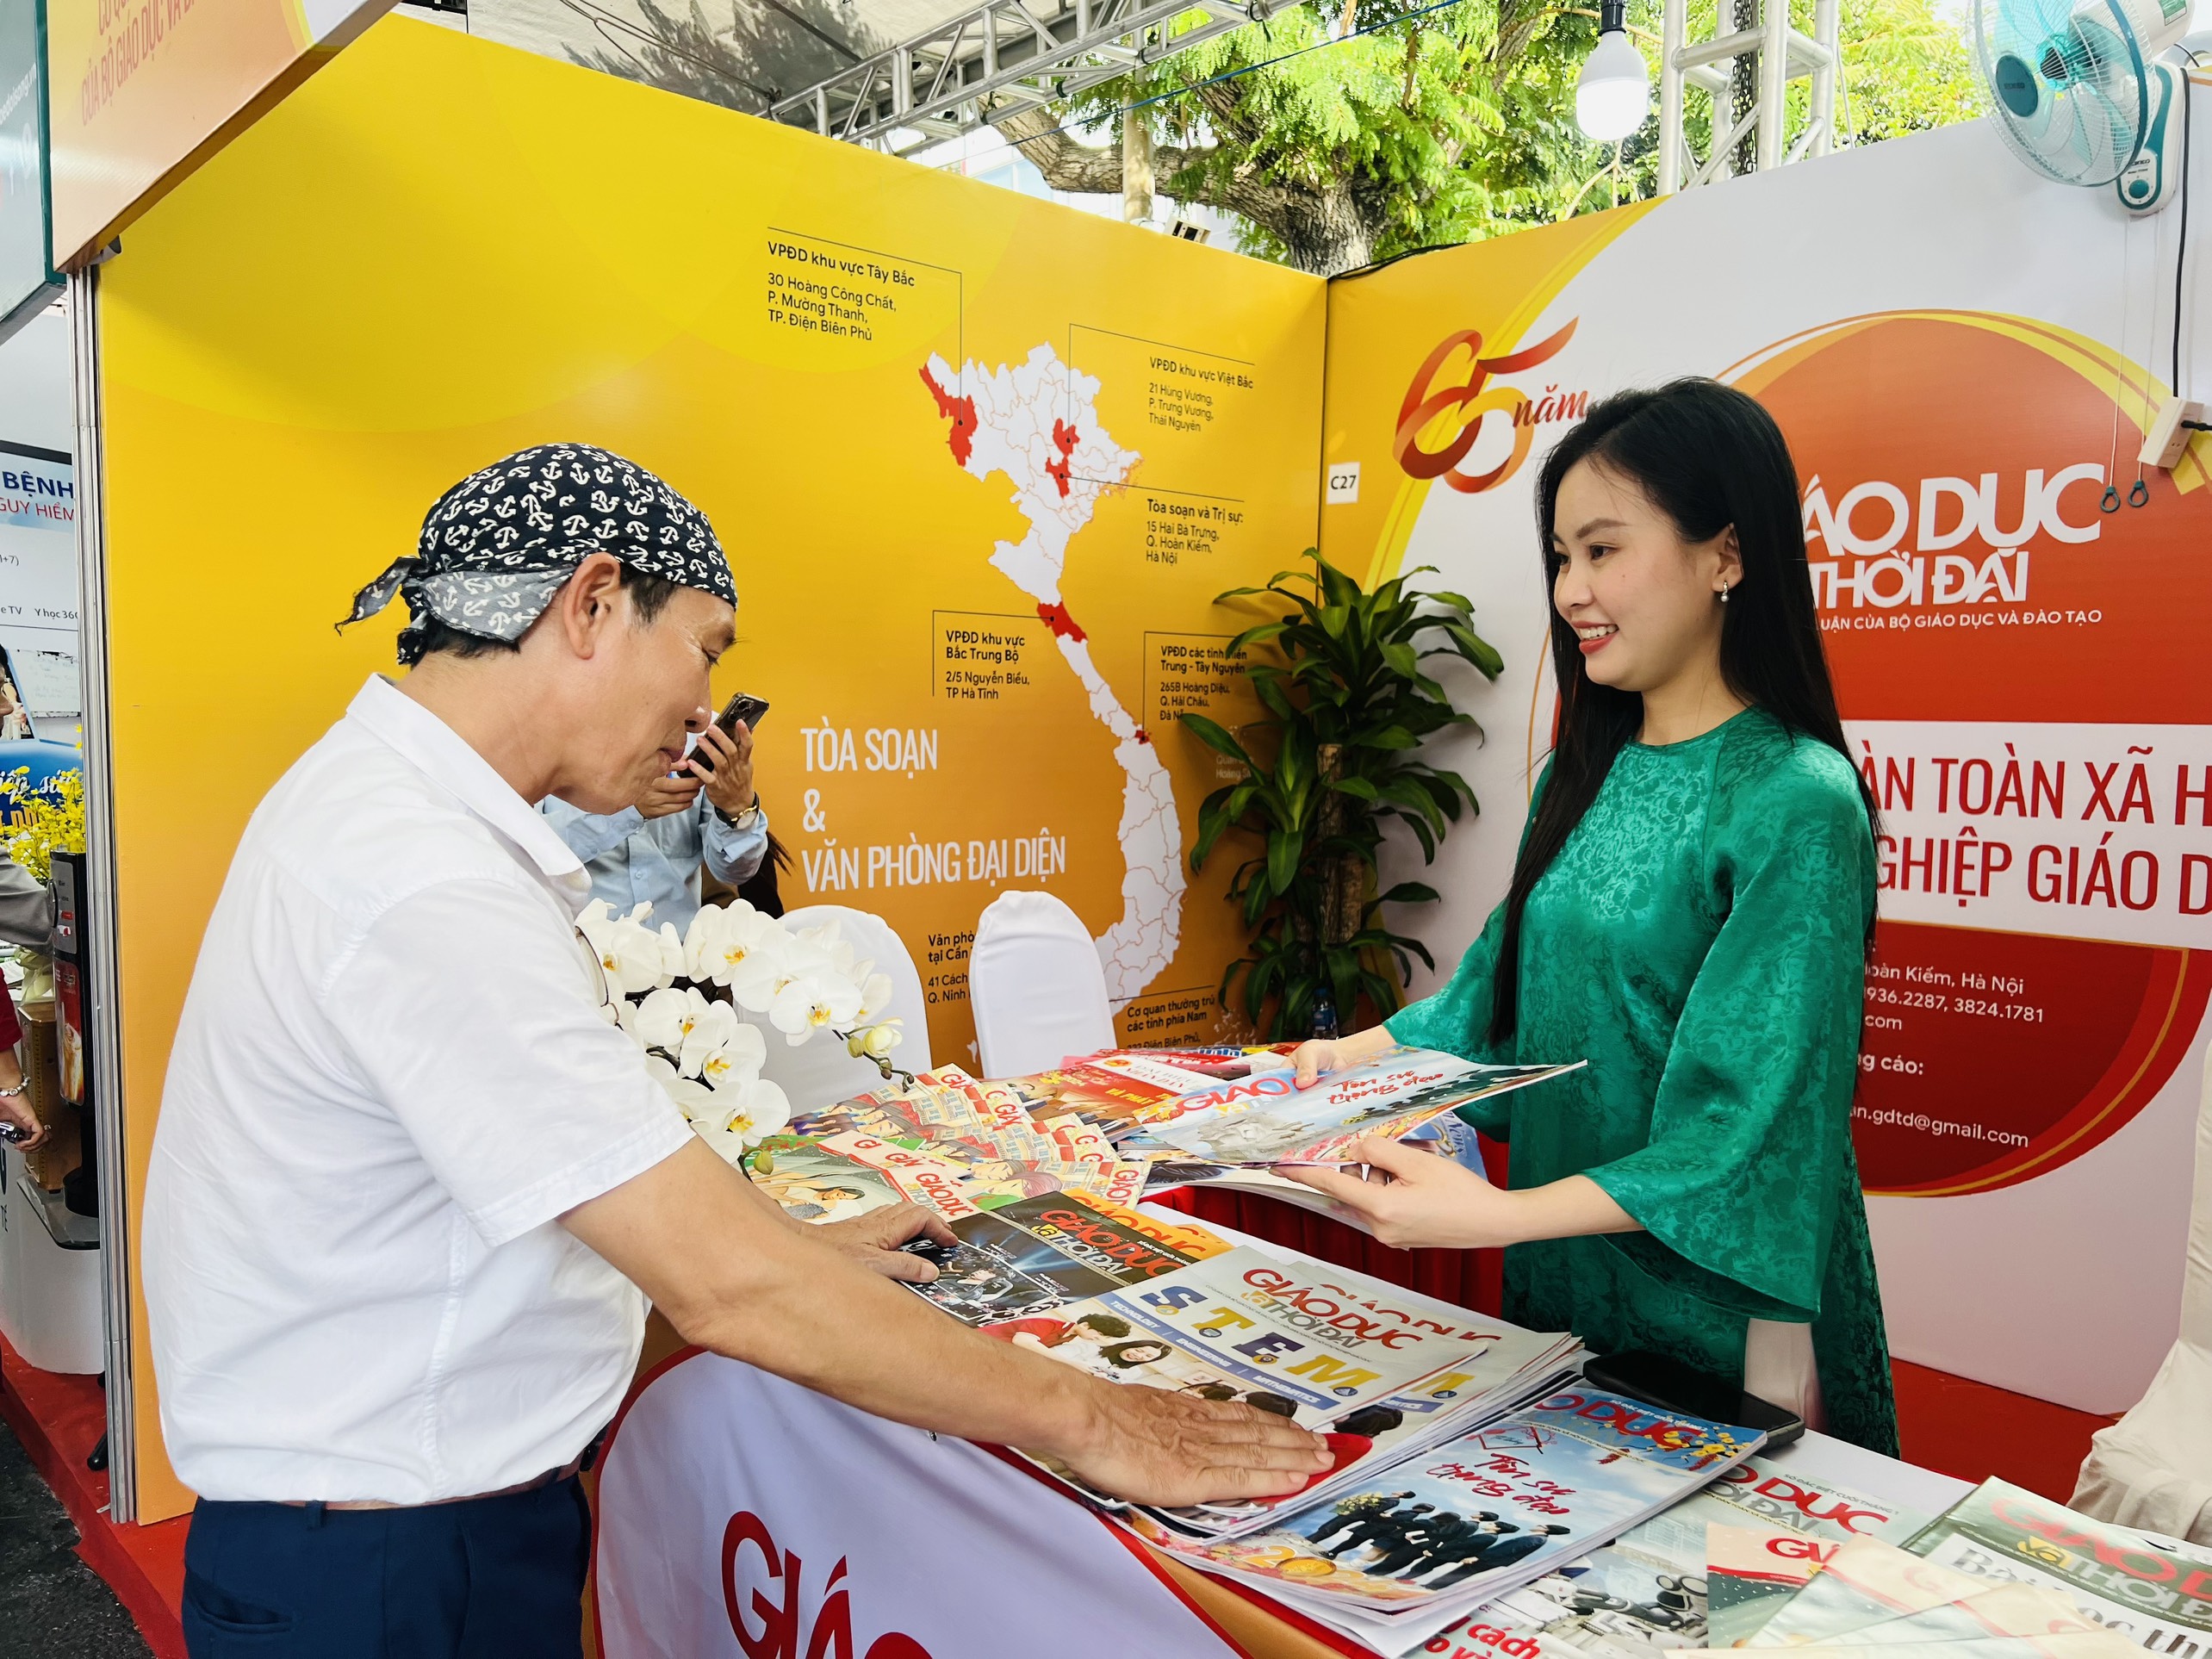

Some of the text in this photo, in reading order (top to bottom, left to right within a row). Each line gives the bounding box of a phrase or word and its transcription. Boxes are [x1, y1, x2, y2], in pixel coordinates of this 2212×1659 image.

[82, 58, 100, 126] CỦA
[102, 35, 115, 107] BỘ
[116, 9, 140, 88] GIÁO
[767, 241, 916, 287] VPĐD khu vực Tây Bắc
[767, 272, 897, 312] 30 Hoàng Công Chất,
[767, 291, 868, 324] P. Mường Thanh,
[767, 309, 873, 341] TP. Điện Biên Phủ
[1149, 357, 1254, 389] VPĐD khu vực Việt Bắc
[1149, 382, 1159, 393] 21
[1160, 385, 1183, 401] Hùng
[1149, 398, 1157, 409] P.
[1159, 399, 1184, 416] Trưng
[1392, 314, 1579, 494] 65
[1513, 383, 1588, 428] năm
[1169, 417, 1202, 432] Nguyên
[2, 471, 74, 499] BỆNH
[1331, 475, 1357, 490] C27
[0, 497, 29, 514] GUY
[1147, 498, 1166, 513] Tòa
[1170, 503, 1195, 519] soạn
[1197, 506, 1210, 519] và
[1212, 506, 1226, 524] Trị
[1804, 463, 2104, 557] ÁO DỤC
[1146, 520, 1220, 542] 15 Hai Bà Trưng,
[1146, 535, 1213, 554] Q. Hoàn Kiếm,
[1146, 550, 1177, 567] Hà Nội
[1931, 550, 2029, 604] ĐẠI
[8, 606, 22, 615] TV
[43, 608, 60, 620] học
[1817, 607, 2103, 633] UẬN CỦA BỘ GIÁO DỤC VÀ ĐÀO TẠO
[946, 630, 1026, 648] VPĐD khu vực
[946, 644, 1019, 665] Bắc Trung Bộ
[1161, 646, 1223, 658] VPĐD các tỉnh
[946, 671, 1030, 687] 2/5 Nguyễn Biểu,
[1161, 660, 1187, 674] Trung
[1195, 661, 1210, 675] Tây
[1212, 662, 1246, 675] Nguyên
[946, 687, 999, 700] TP Hà Tĩnh
[1159, 696, 1170, 706] Q.
[1171, 696, 1185, 706] Hải
[1160, 682, 1180, 693] 265B
[1183, 683, 1209, 696] Hoàng
[1159, 710, 1171, 720] Đà
[800, 716, 937, 779] TÒA SOẠN
[1861, 740, 2154, 824] ÀN TOÀN XÃ
[803, 788, 825, 832] &
[801, 827, 1066, 892] VĂN PHÒNG ĐẠI DIỆN
[1876, 826, 2159, 910] GHIỆP GIÁO
[929, 930, 976, 947] Văn phò
[929, 946, 968, 965] tại Cần
[929, 972, 968, 987] 41 Cách
[1905, 966, 1955, 988] Kiếm,
[1961, 973, 1985, 990] Hà
[1991, 975, 2024, 997] Nội
[929, 989, 966, 1003] Q. Ninh
[1128, 1007, 1140, 1017] Cơ
[1143, 1004, 1165, 1017] quan
[1168, 998, 1199, 1011] thường
[1864, 986, 2043, 1022] 936.2287, 3824.1781
[1128, 1011, 1207, 1032] các tỉnh phía Nam
[1880, 1055, 1923, 1075] cáo:
[1176, 1078, 1291, 1112] GIÁO
[1040, 1209, 1120, 1247] GIÁO
[1243, 1268, 1341, 1317] GIÁO
[1327, 1312, 1424, 1350] DỤC
[1264, 1298, 1327, 1331] THỜI
[1313, 1325, 1367, 1349] ĐẠI
[1752, 1476, 1889, 1537] DỤC
[722, 1511, 934, 1659] GIÁ
